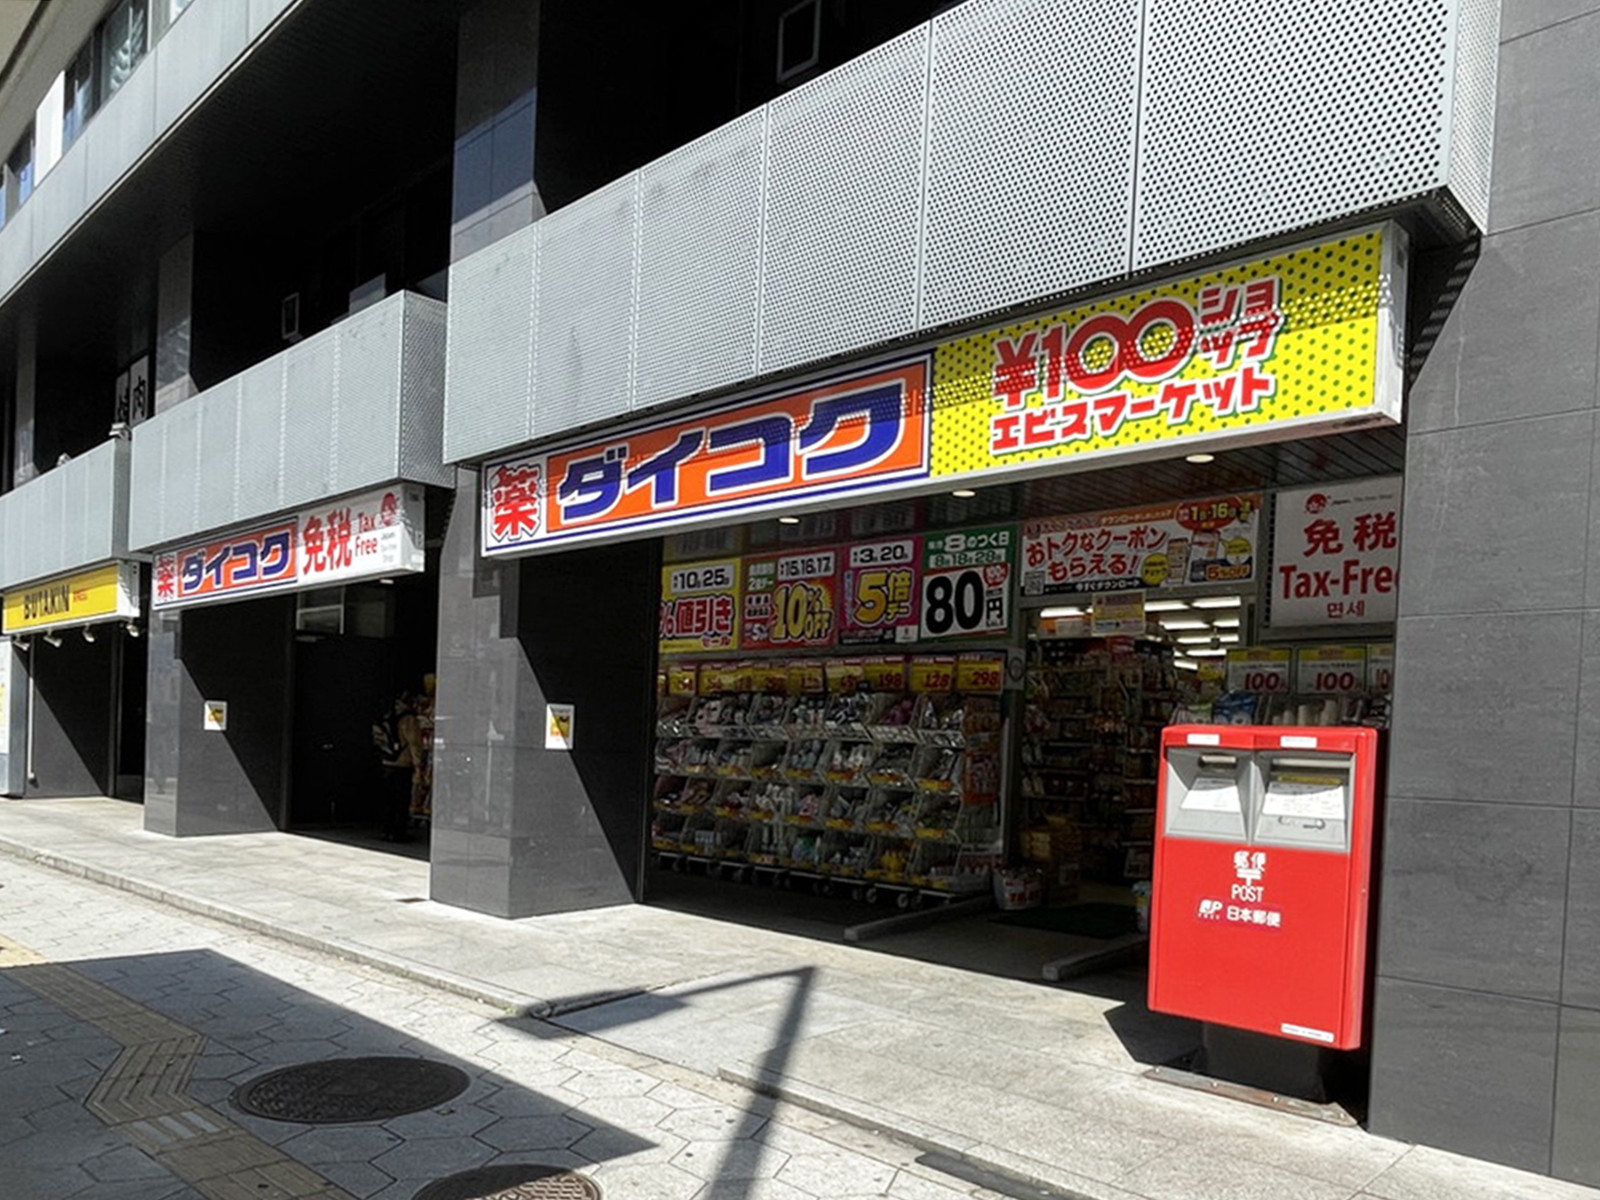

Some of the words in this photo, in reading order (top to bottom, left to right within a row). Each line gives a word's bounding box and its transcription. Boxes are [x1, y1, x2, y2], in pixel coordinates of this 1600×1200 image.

[993, 299, 1196, 410] ¥100
[990, 366, 1276, 455] エビスマーケット
[490, 463, 542, 541] 薬
[556, 379, 906, 525] ダイコク
[358, 512, 376, 533] Tax
[303, 507, 352, 575] 免税
[1303, 511, 1397, 557] 免税
[355, 535, 379, 557] Free
[1027, 525, 1167, 567] おトクなクーポン
[156, 553, 176, 601] 薬
[182, 529, 292, 592] ダイコク
[1279, 559, 1398, 599] Tax-Fre
[1326, 600, 1365, 618] 면세
[805, 612, 832, 639] OFF
[701, 635, 731, 648] セール
[878, 672, 903, 688] 198
[923, 674, 951, 688] 128
[972, 671, 999, 687] 298
[1244, 672, 1280, 690] 100
[1315, 672, 1354, 690] 100
[1234, 850, 1266, 871] 郵便
[1231, 884, 1265, 902] POST
[1226, 905, 1281, 927] 日本郵便
